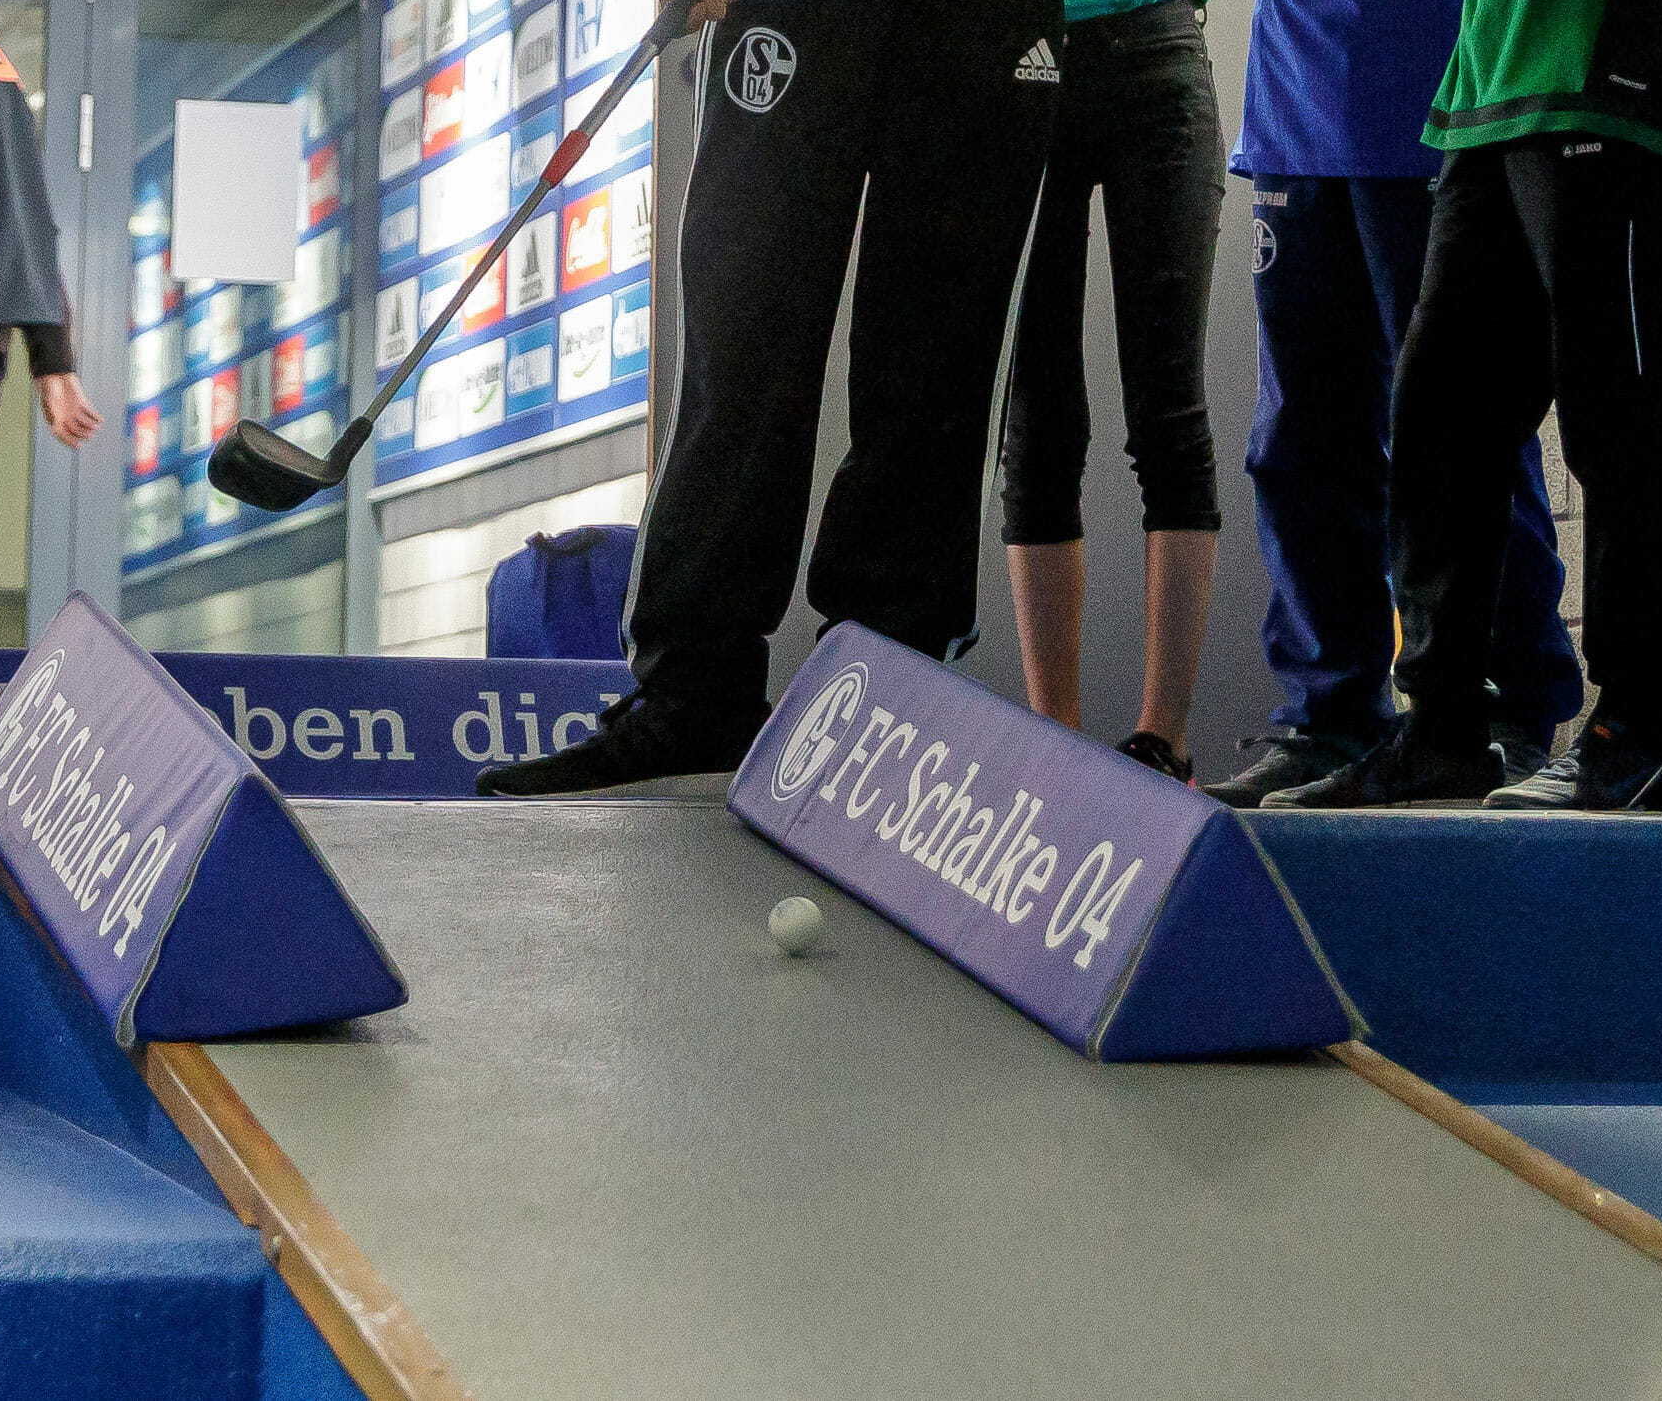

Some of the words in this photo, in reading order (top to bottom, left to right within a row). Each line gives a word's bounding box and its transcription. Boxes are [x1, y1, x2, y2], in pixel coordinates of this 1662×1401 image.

[202, 687, 416, 762] ben
[451, 692, 622, 762] dic
[819, 705, 919, 819] FC
[874, 741, 1059, 924] Schalke
[1044, 840, 1144, 970] 04
[20, 726, 135, 913] Schalke
[98, 825, 178, 960] 04
